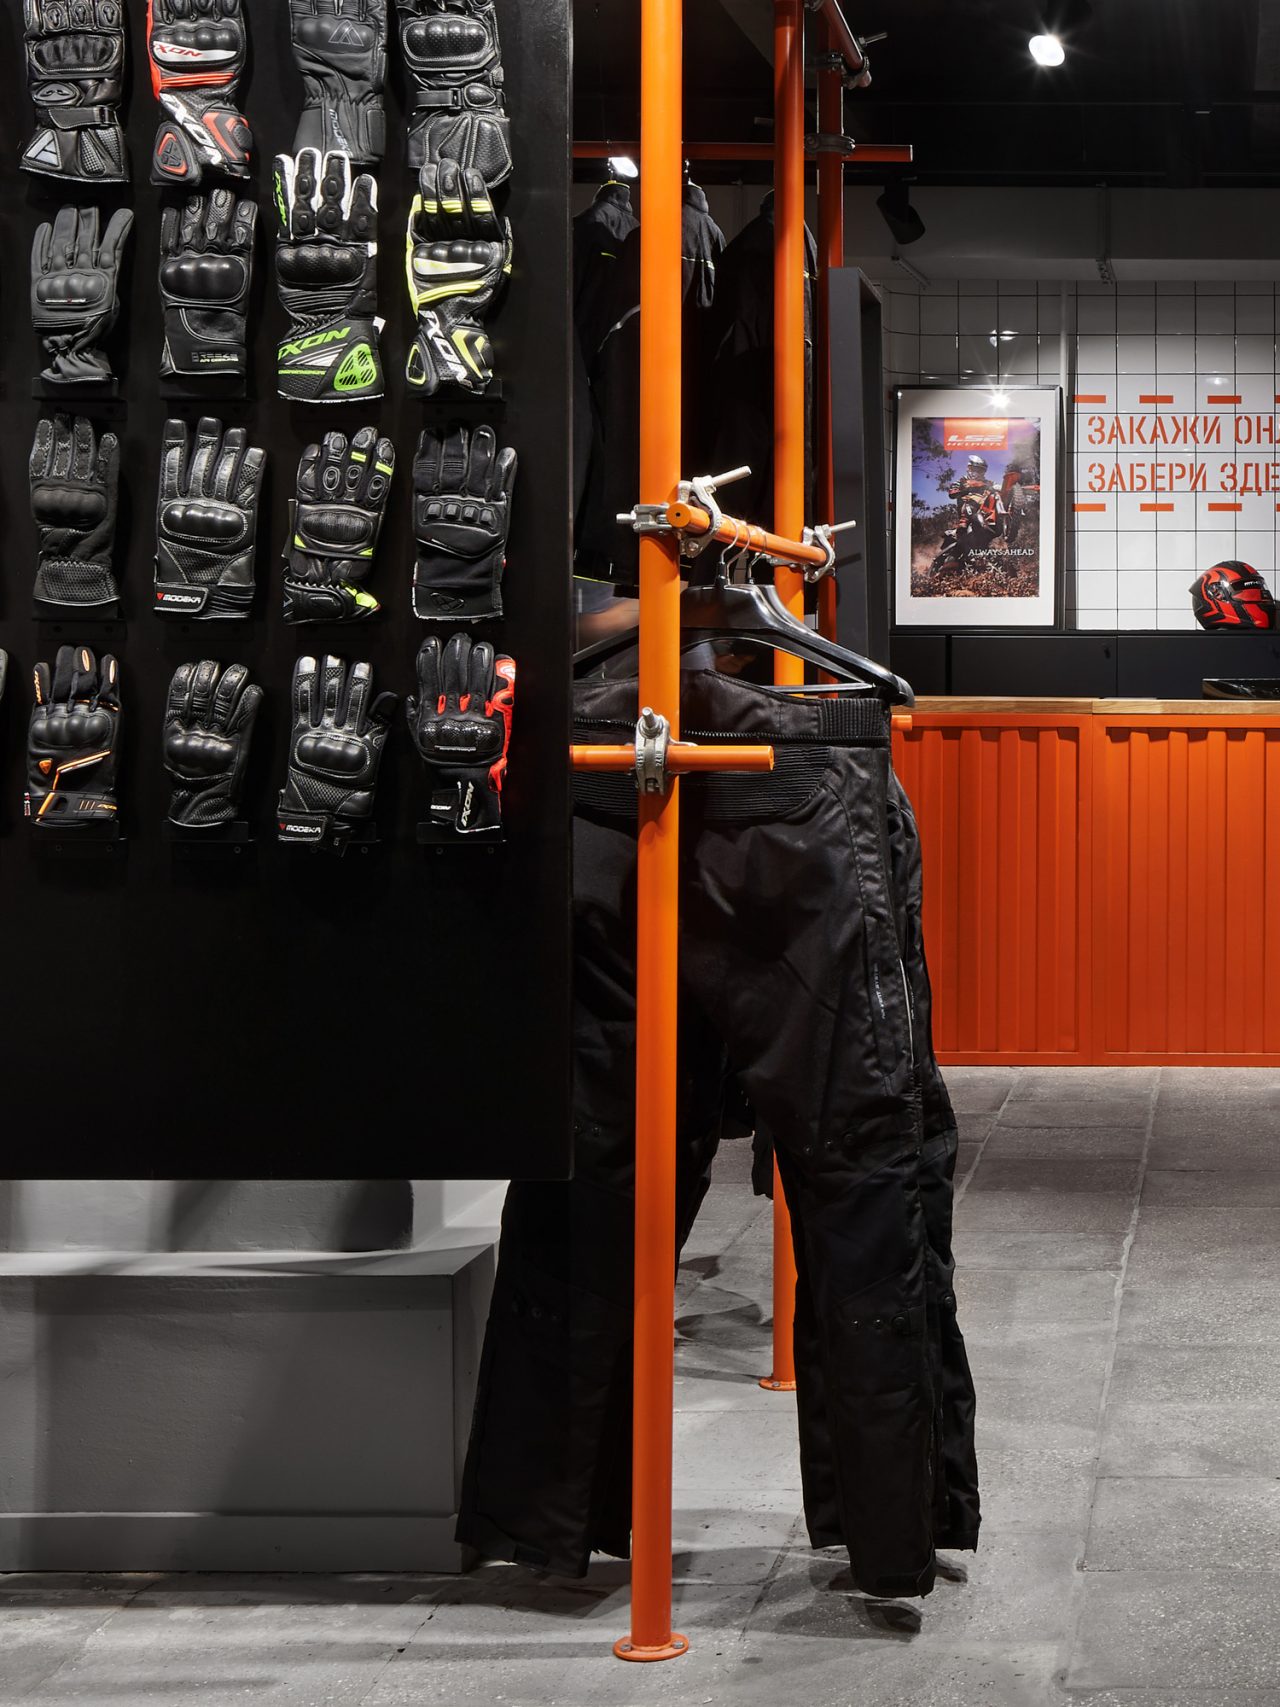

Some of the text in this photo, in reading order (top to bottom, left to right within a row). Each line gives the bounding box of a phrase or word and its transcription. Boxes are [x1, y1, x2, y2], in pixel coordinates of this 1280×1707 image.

[156, 44, 203, 57] XON
[1087, 415, 1221, 445] ЗАКАЖИ
[947, 434, 1005, 442] LS2
[1087, 462, 1207, 492] ЗАБЕРИ
[968, 548, 1035, 557] ALWAYS AHEAD
